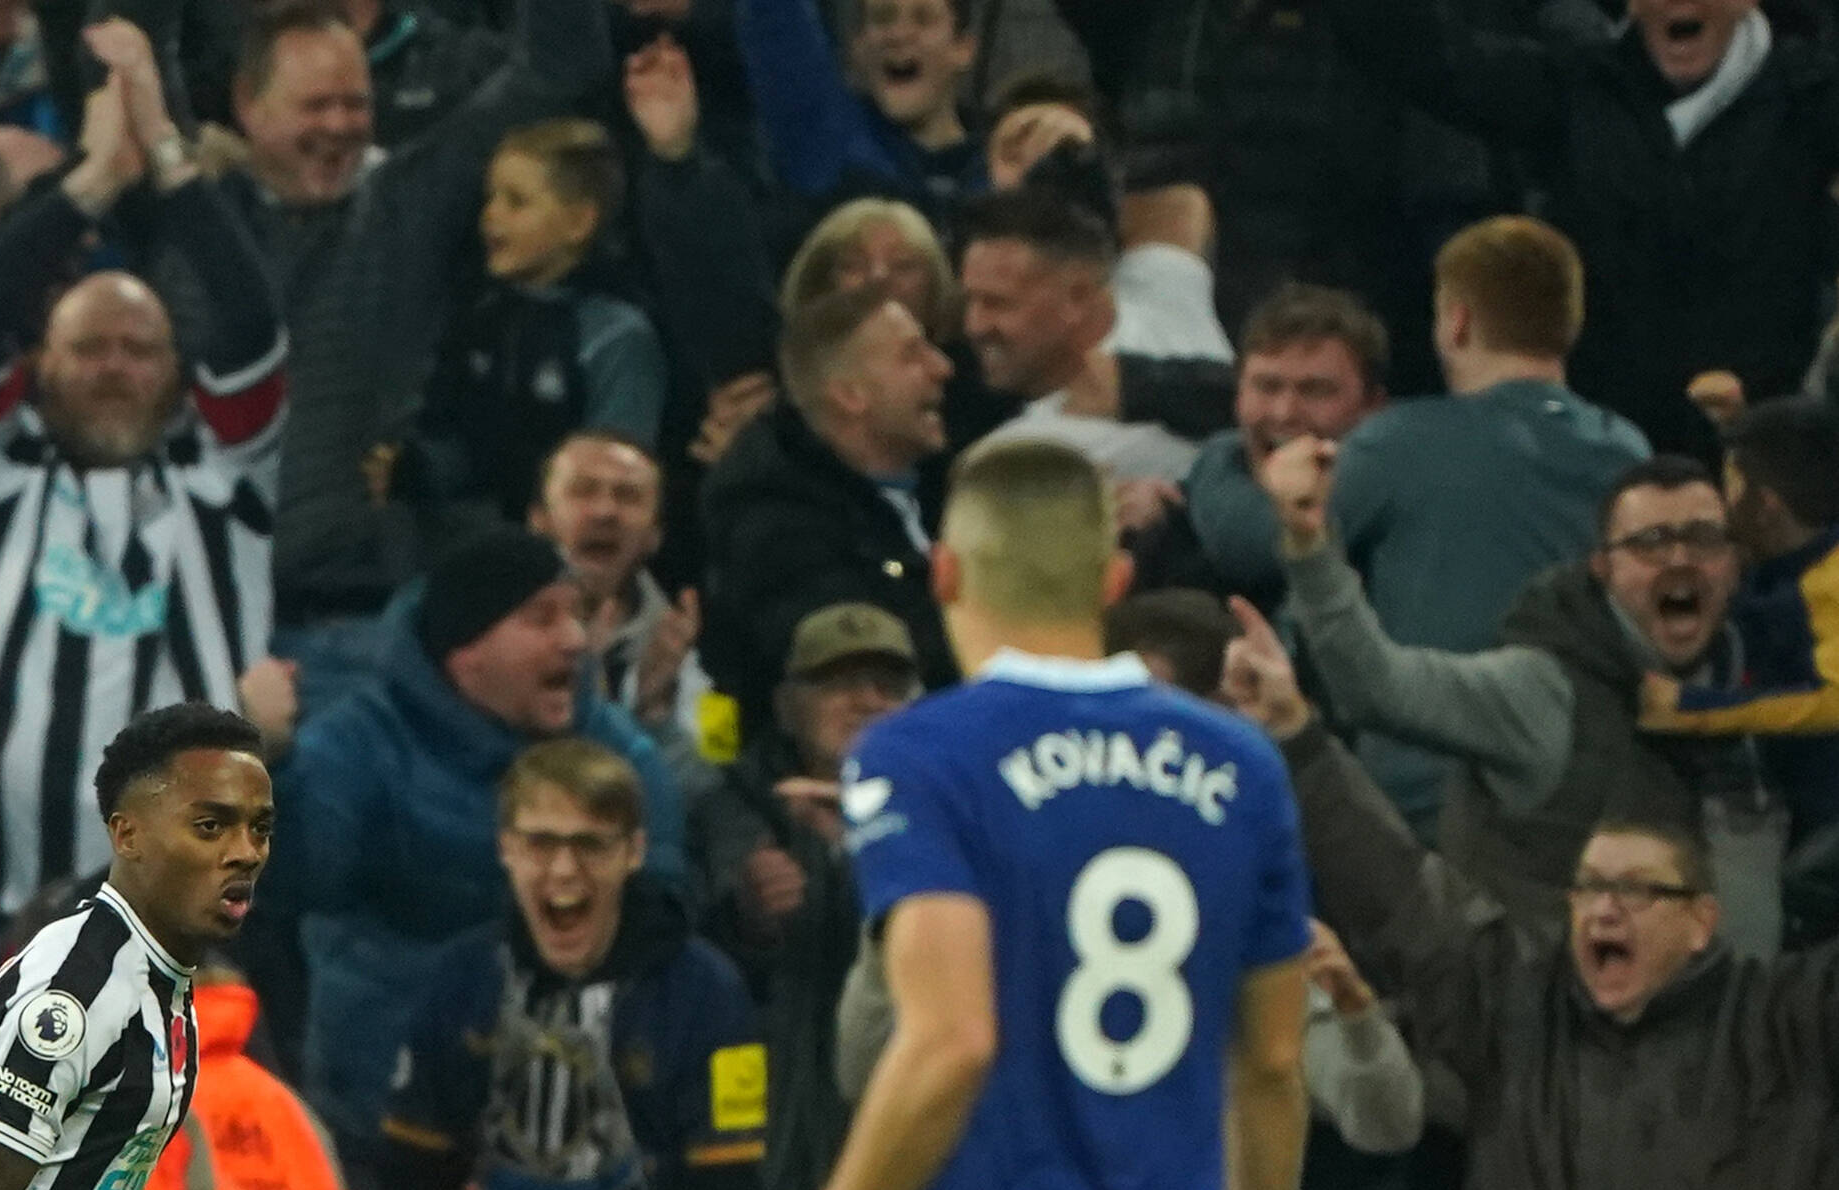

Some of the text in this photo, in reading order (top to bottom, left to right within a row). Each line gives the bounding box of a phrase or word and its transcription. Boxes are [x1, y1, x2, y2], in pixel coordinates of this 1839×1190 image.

[1055, 845, 1200, 1096] 8
[9, 1087, 52, 1116] racism
[14, 1076, 52, 1103] room
